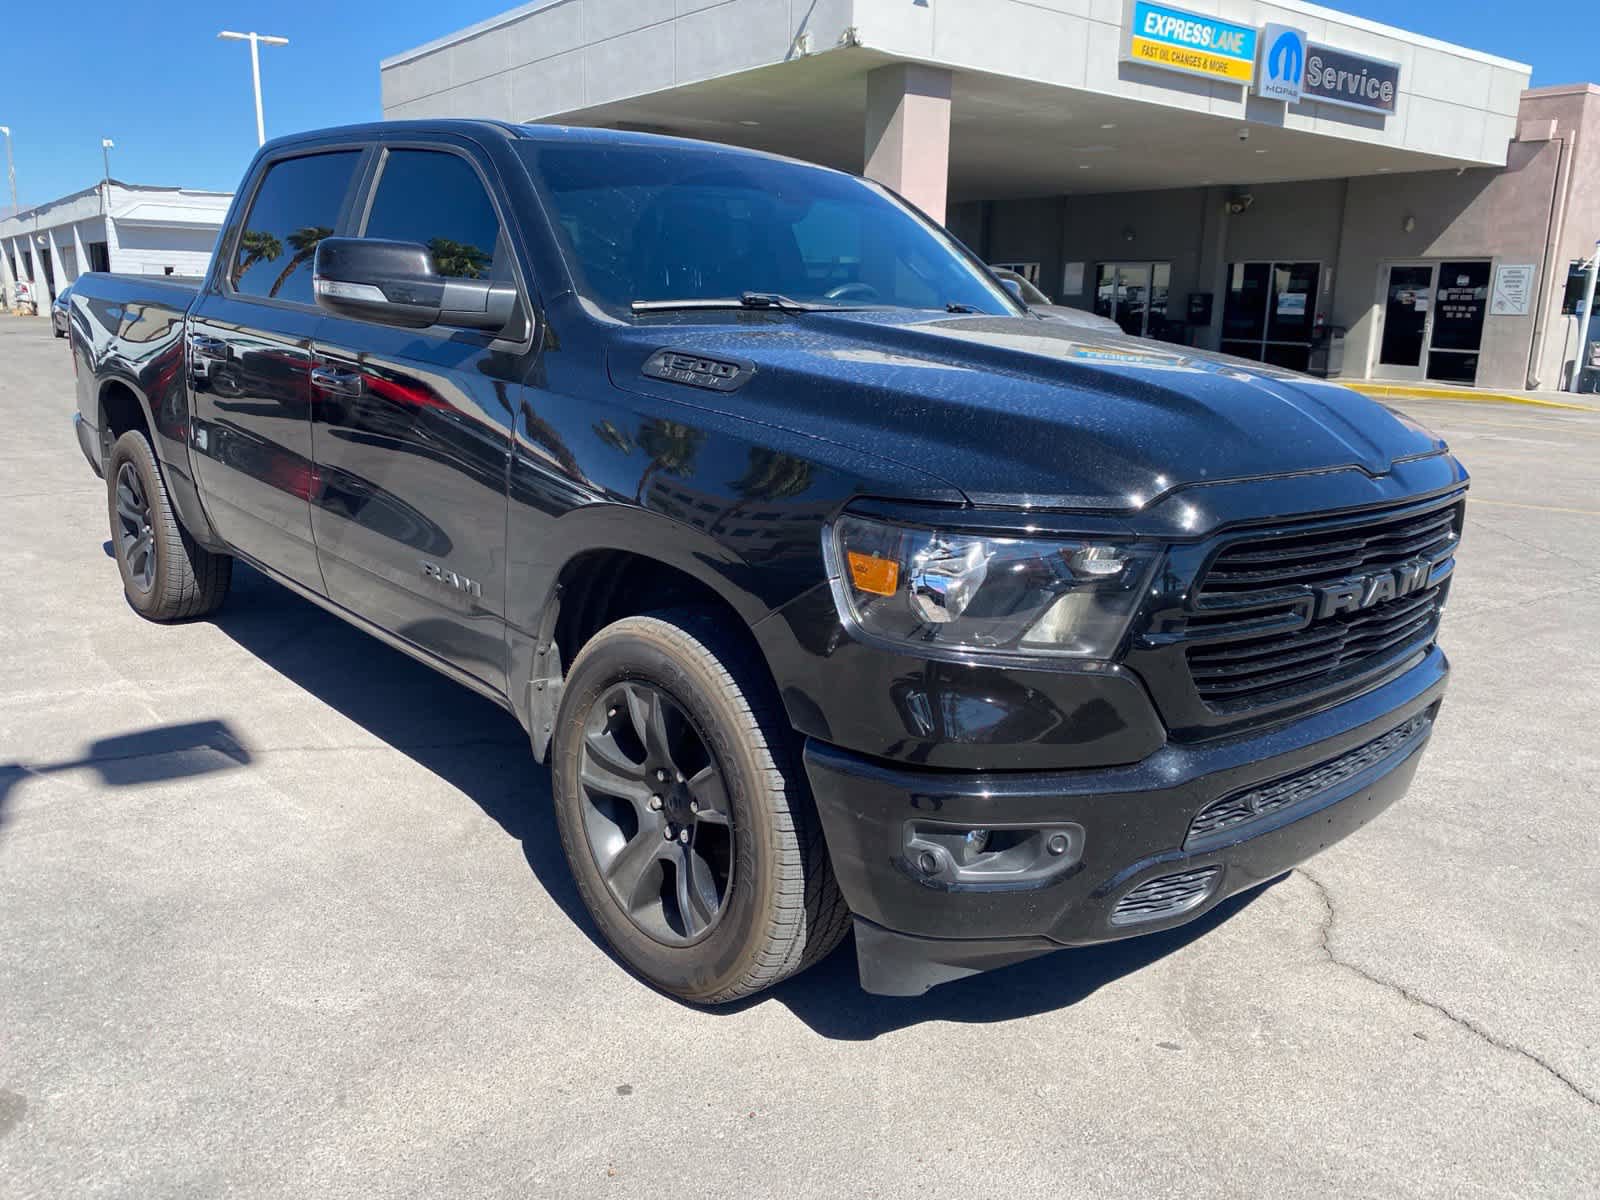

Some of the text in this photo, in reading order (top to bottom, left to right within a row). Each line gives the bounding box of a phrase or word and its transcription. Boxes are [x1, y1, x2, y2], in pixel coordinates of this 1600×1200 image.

[1144, 12, 1244, 53] EXPRESSLANE
[1142, 45, 1229, 73] FAST OIL CHANGES & MORE
[1266, 85, 1299, 98] MOPAR
[1307, 56, 1394, 102] Service
[655, 353, 740, 378] 1500
[421, 560, 481, 598] RAM
[1316, 560, 1432, 620] RAM
